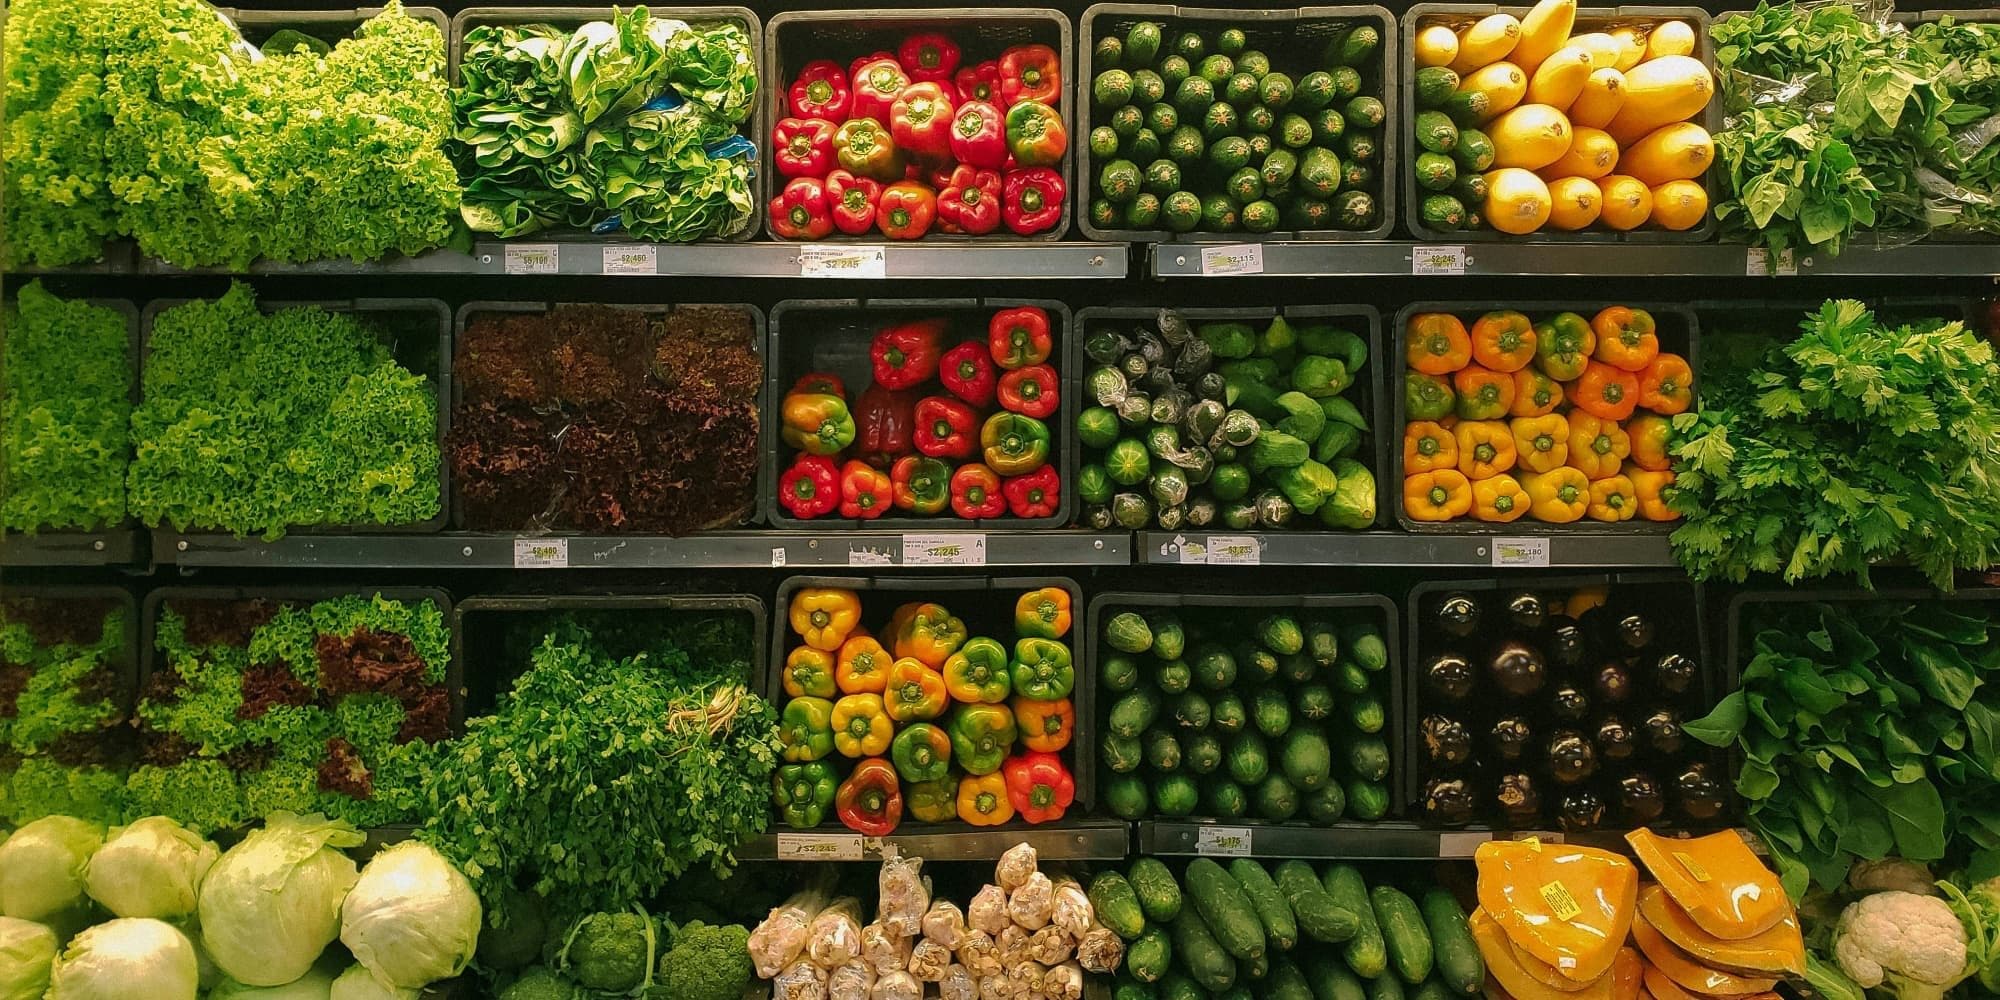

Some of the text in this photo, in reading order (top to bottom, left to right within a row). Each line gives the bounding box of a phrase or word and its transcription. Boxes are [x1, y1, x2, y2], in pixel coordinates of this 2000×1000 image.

[875, 252, 883, 260] A
[975, 540, 983, 548] A
[927, 547, 960, 557] $2,245
